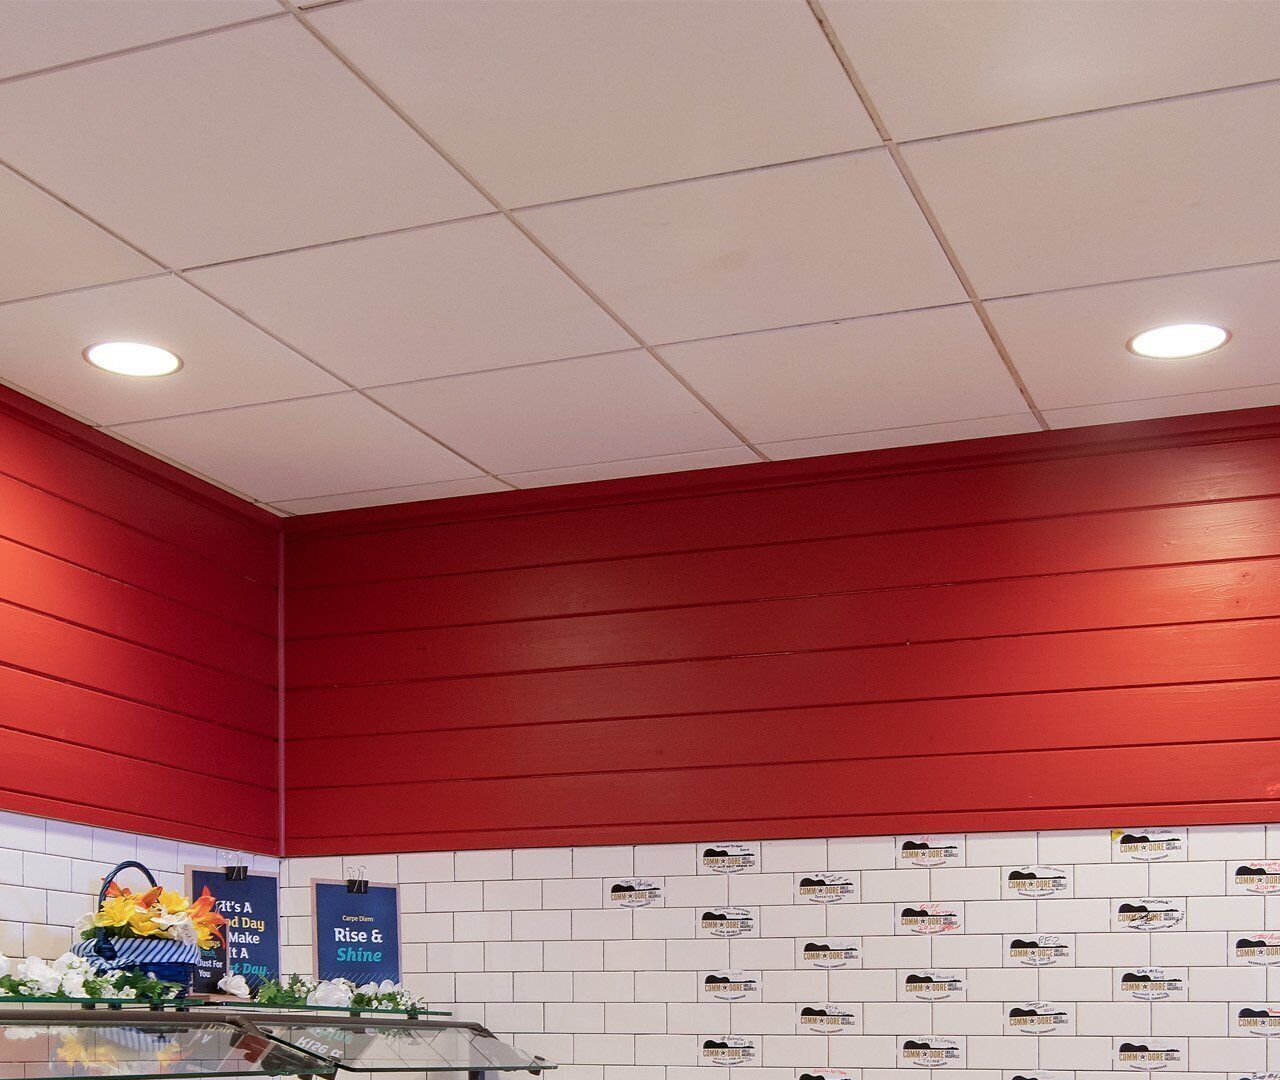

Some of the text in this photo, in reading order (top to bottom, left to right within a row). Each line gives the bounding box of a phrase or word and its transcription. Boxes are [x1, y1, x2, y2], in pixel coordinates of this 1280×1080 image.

[243, 902, 252, 913] A
[242, 917, 264, 932] Day
[228, 932, 260, 943] Make
[334, 927, 383, 943] Rise &
[240, 948, 249, 958] A
[336, 946, 382, 962] Shine
